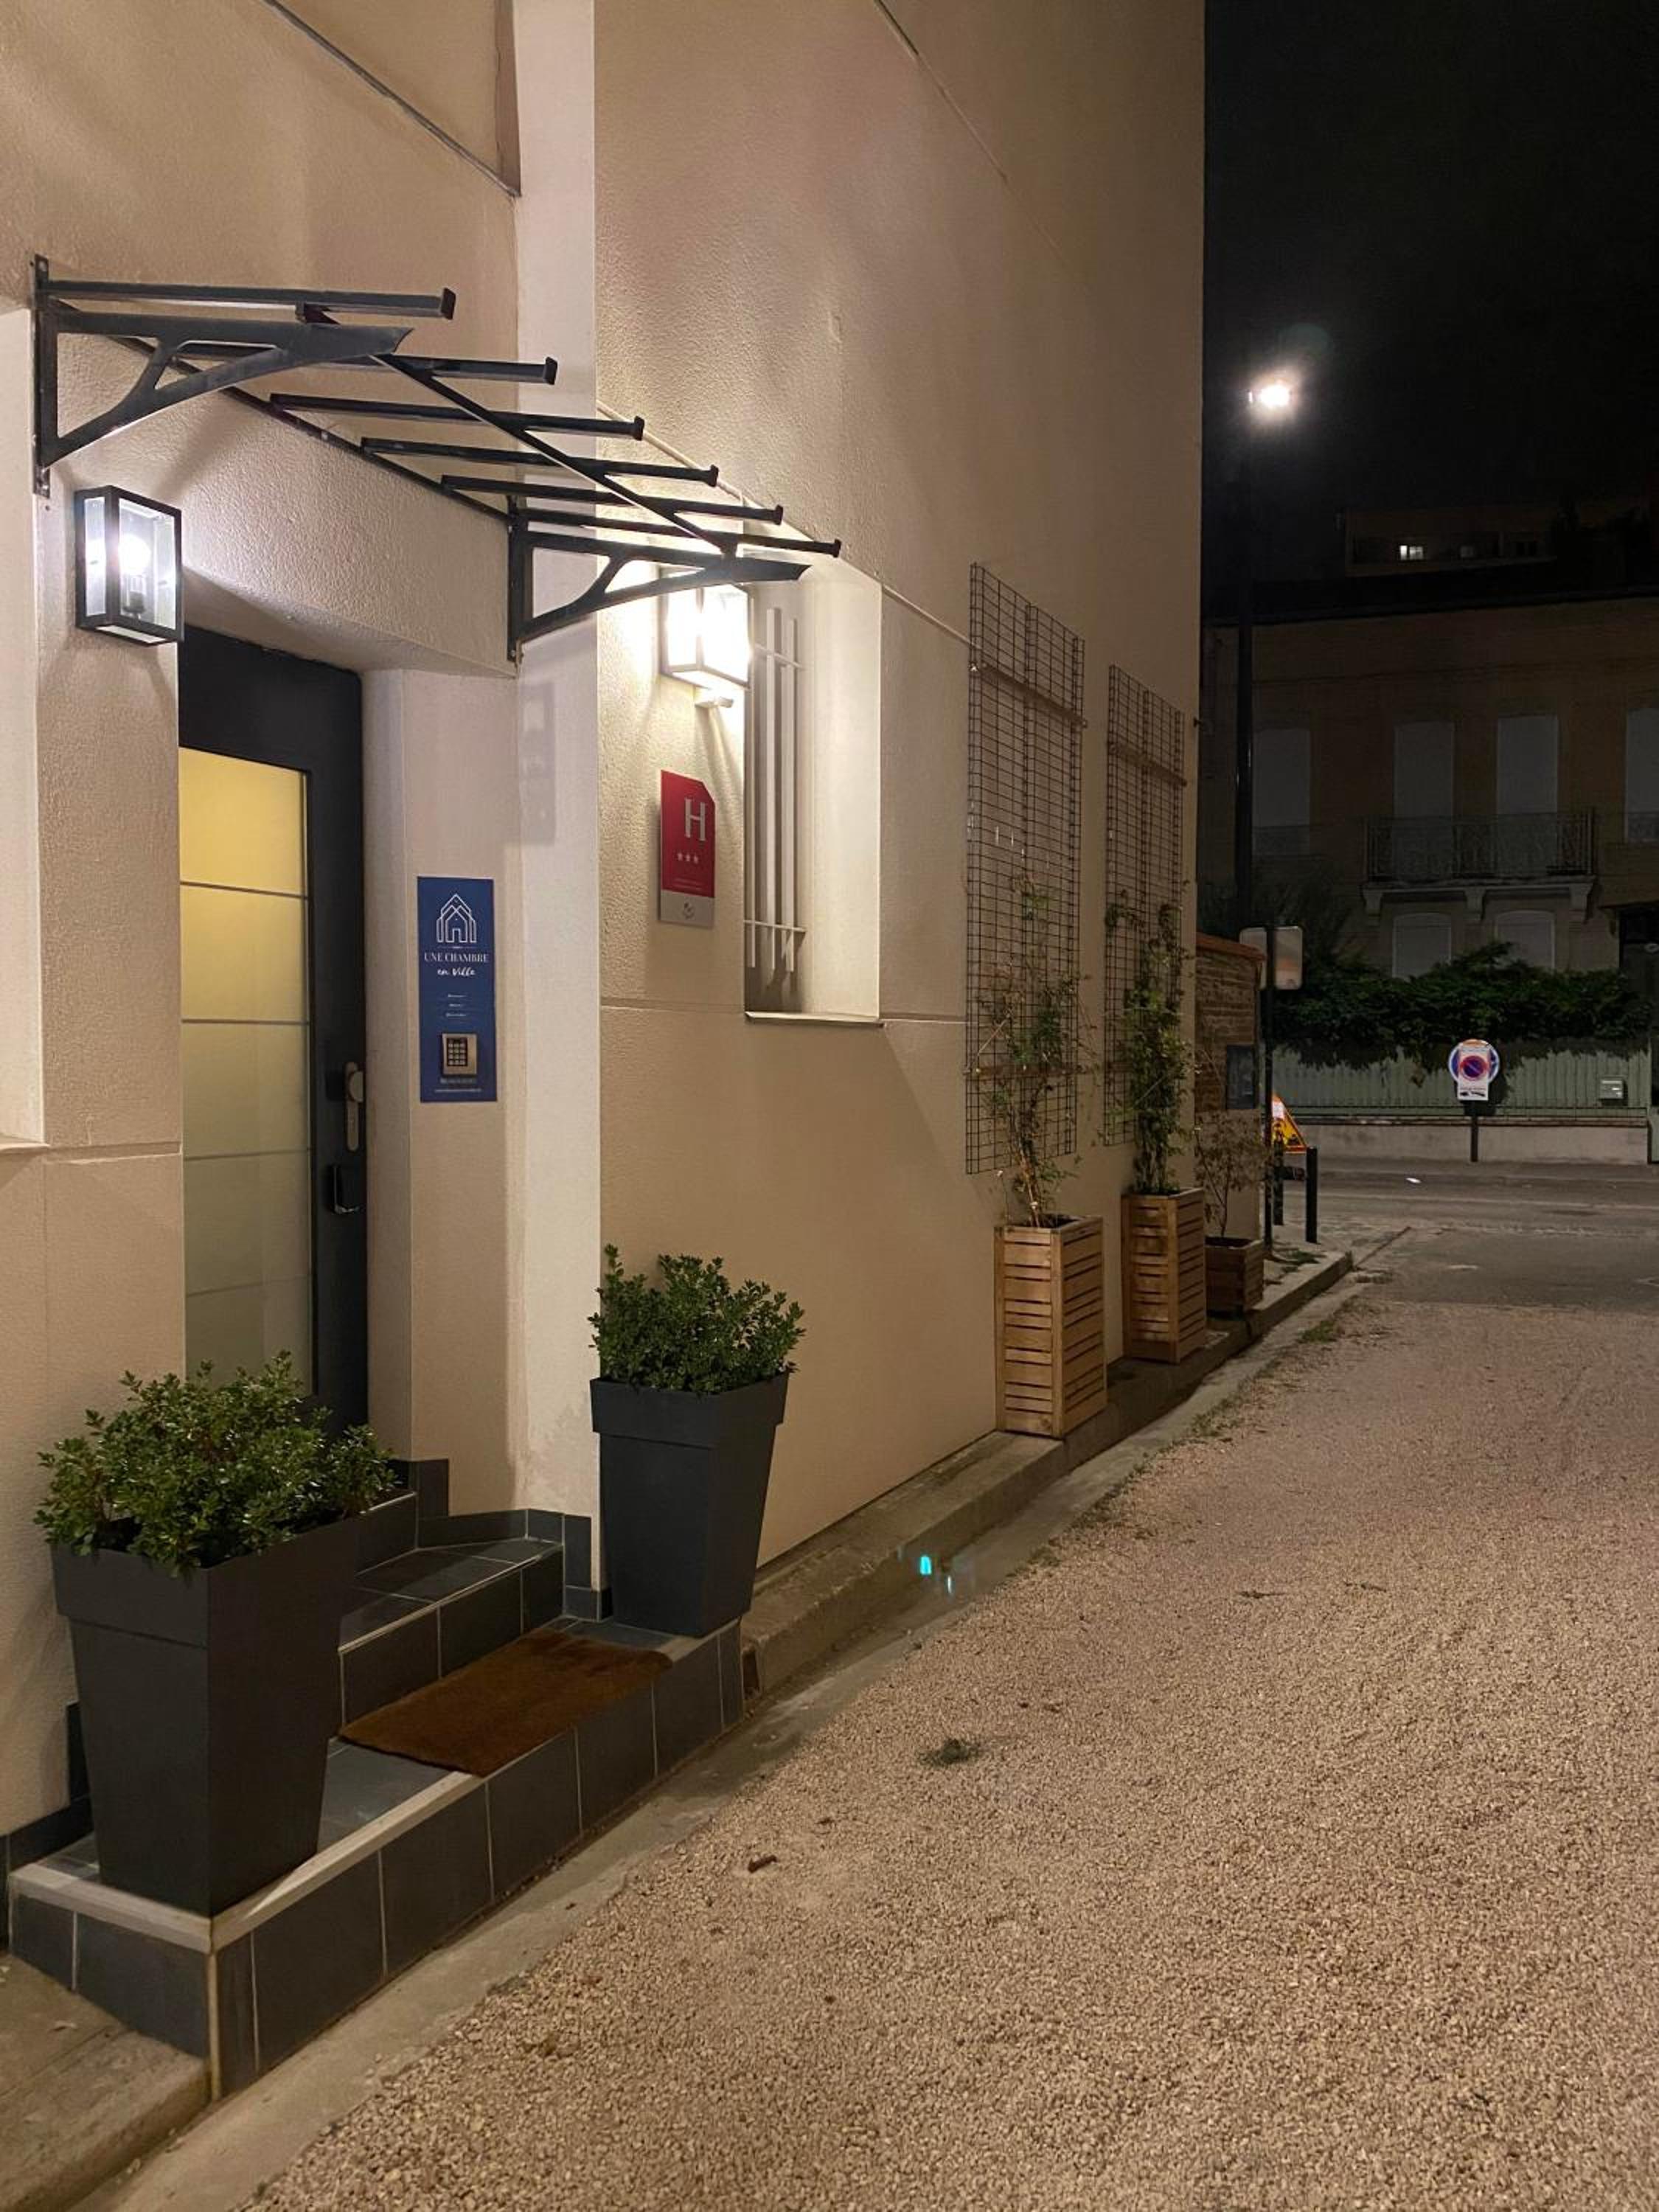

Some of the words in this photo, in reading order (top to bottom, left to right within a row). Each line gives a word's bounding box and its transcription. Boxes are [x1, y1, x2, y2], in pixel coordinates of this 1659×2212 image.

[684, 798, 706, 841] H
[424, 952, 443, 962] UNE
[445, 953, 488, 963] CHAMBRE
